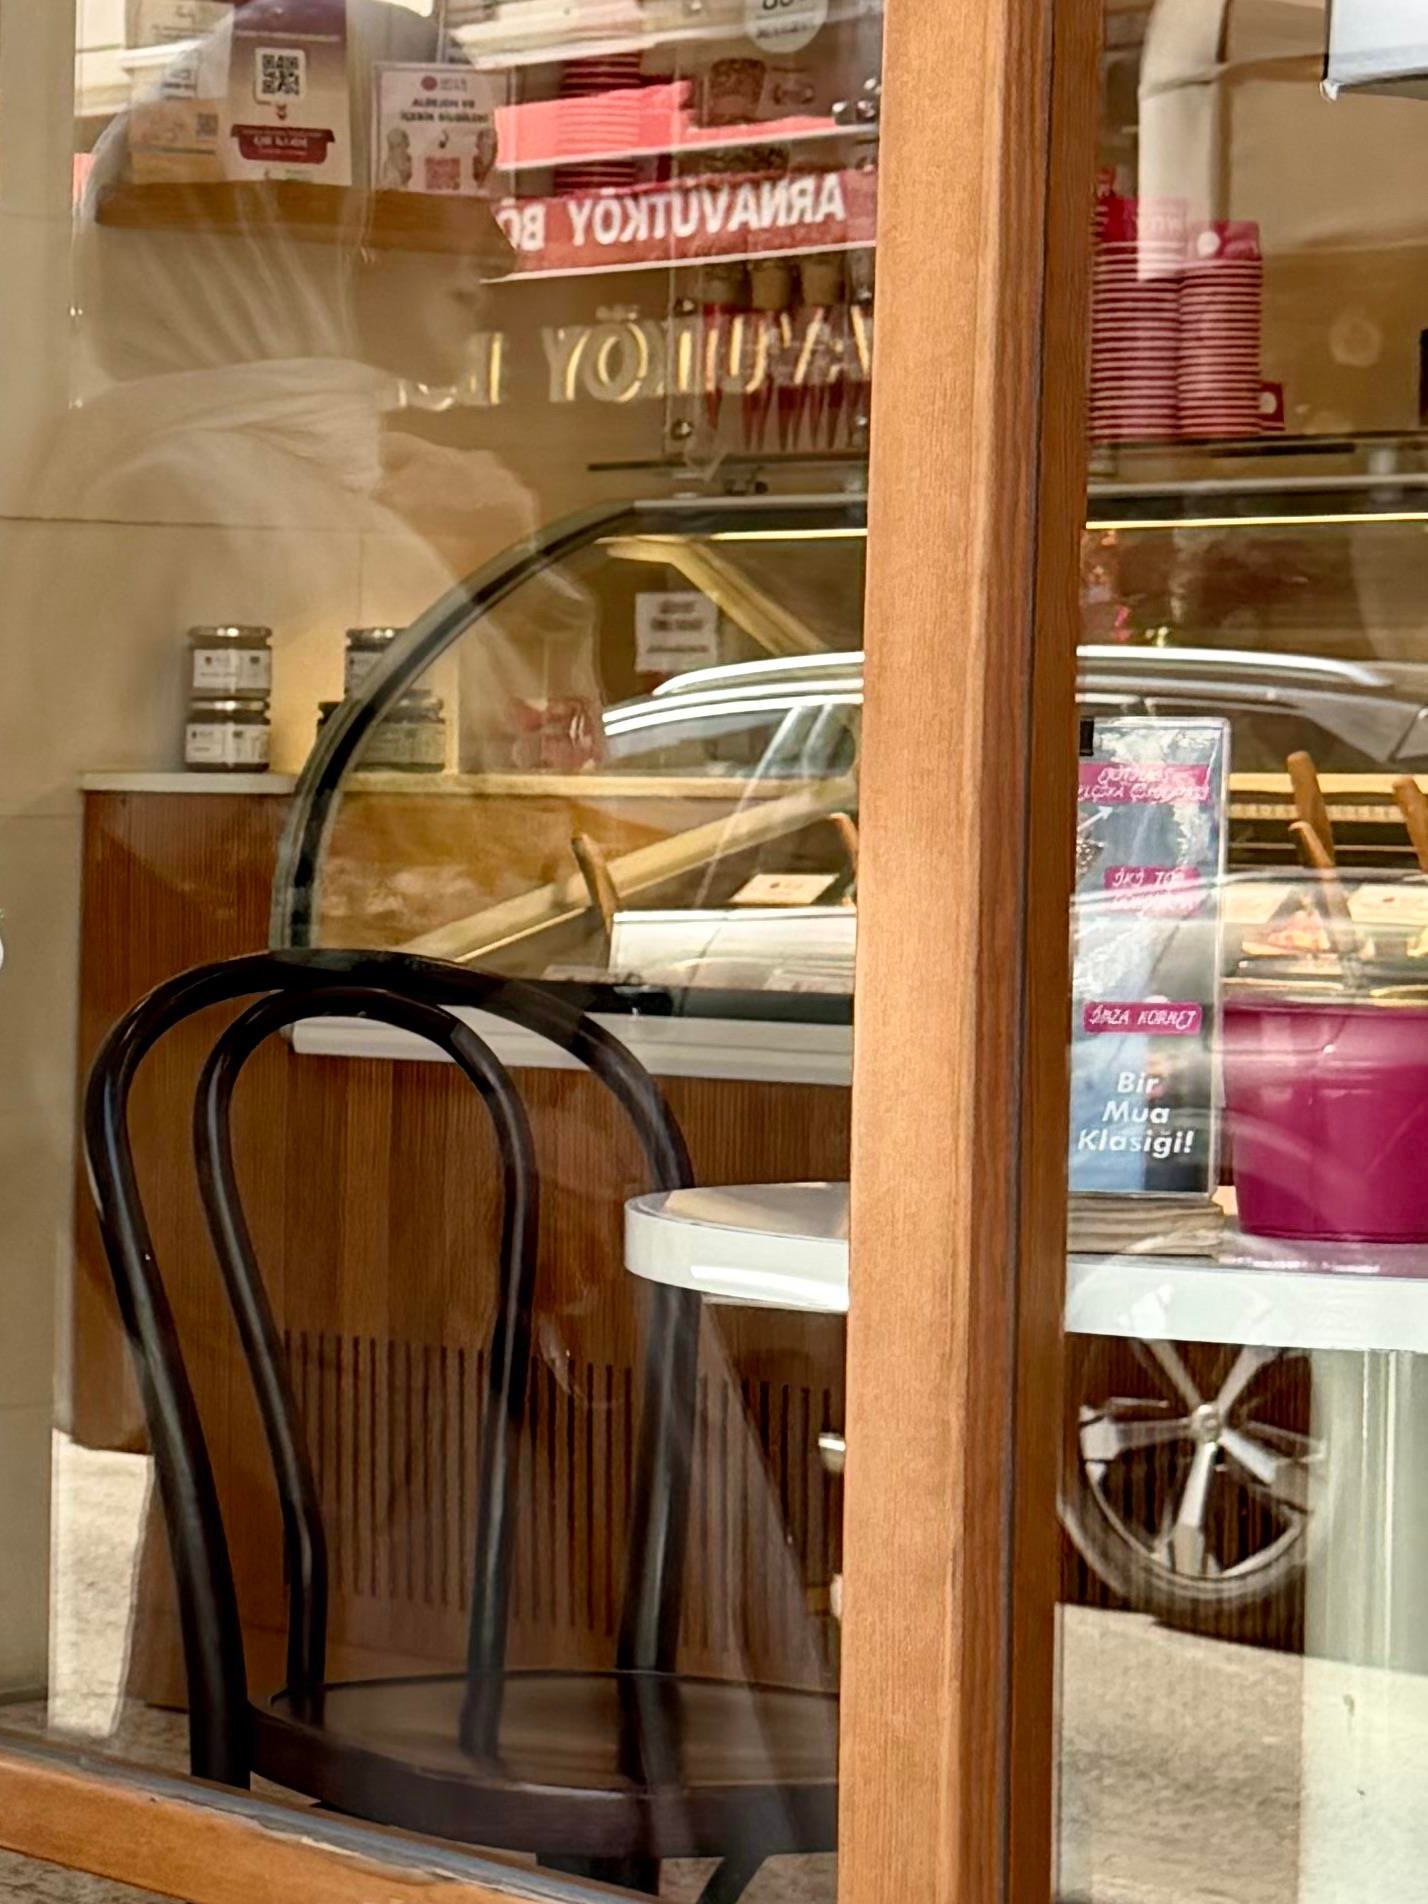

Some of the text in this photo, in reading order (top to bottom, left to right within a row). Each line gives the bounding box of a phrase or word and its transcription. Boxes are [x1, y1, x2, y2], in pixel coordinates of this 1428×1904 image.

[1116, 1071, 1161, 1094] Bir
[1101, 1099, 1171, 1125] Mua
[1077, 1128, 1195, 1160] Klasiği!
